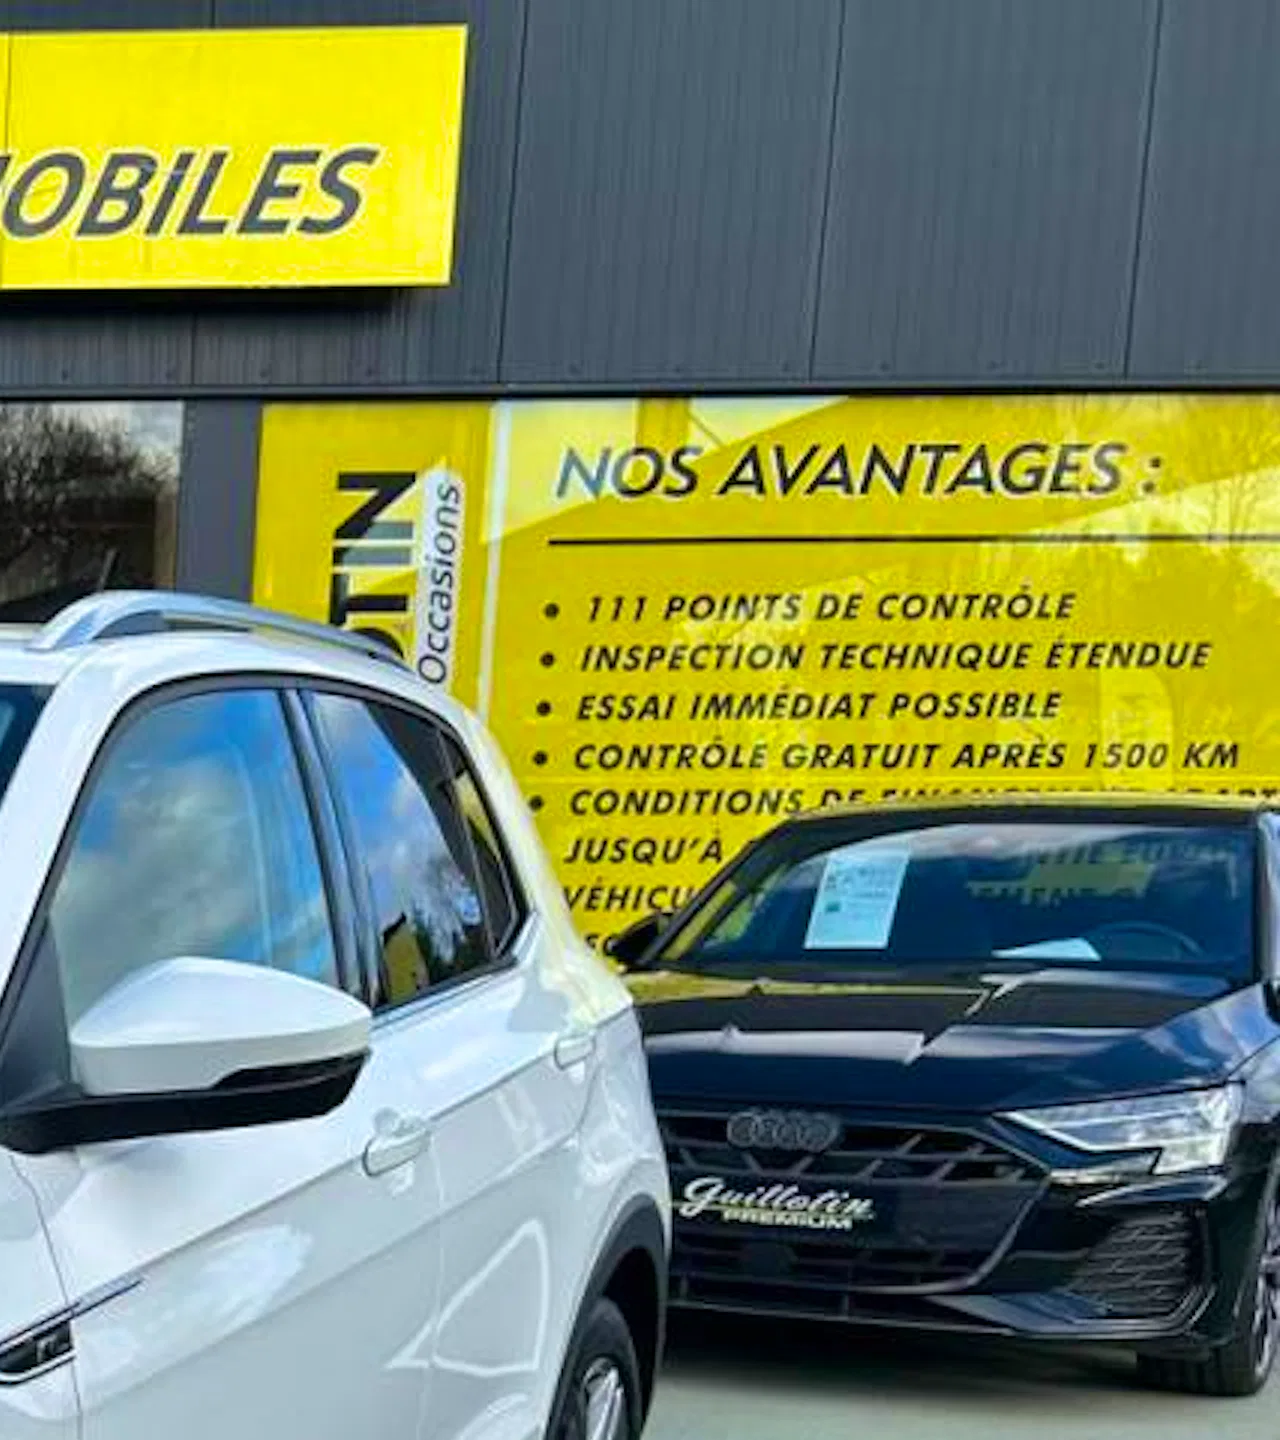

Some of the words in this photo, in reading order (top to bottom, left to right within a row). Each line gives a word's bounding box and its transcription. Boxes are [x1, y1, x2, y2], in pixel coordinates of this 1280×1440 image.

[556, 446, 702, 499] NOS
[717, 443, 1127, 496] AVANTAGES
[417, 483, 461, 685] Occasions
[588, 595, 647, 622] 111
[664, 593, 801, 622] POINTS
[816, 593, 864, 621] DE
[877, 585, 1077, 621] CONTRÔLE
[580, 645, 804, 673] INSPECTION
[819, 643, 1033, 671] TECHNIQUE
[1045, 636, 1212, 669] ÉTENDUE
[576, 694, 676, 721] ESSAI
[689, 686, 877, 721] IMMÉDIAT
[887, 692, 1063, 719] POSSIBLE
[574, 738, 765, 769] CONTRÔLE
[782, 743, 941, 769] GRATUIT
[952, 737, 1068, 769] APRÈS
[1084, 743, 1170, 769] 1500
[1182, 743, 1241, 768] KM
[570, 788, 803, 816] CONDITIONS
